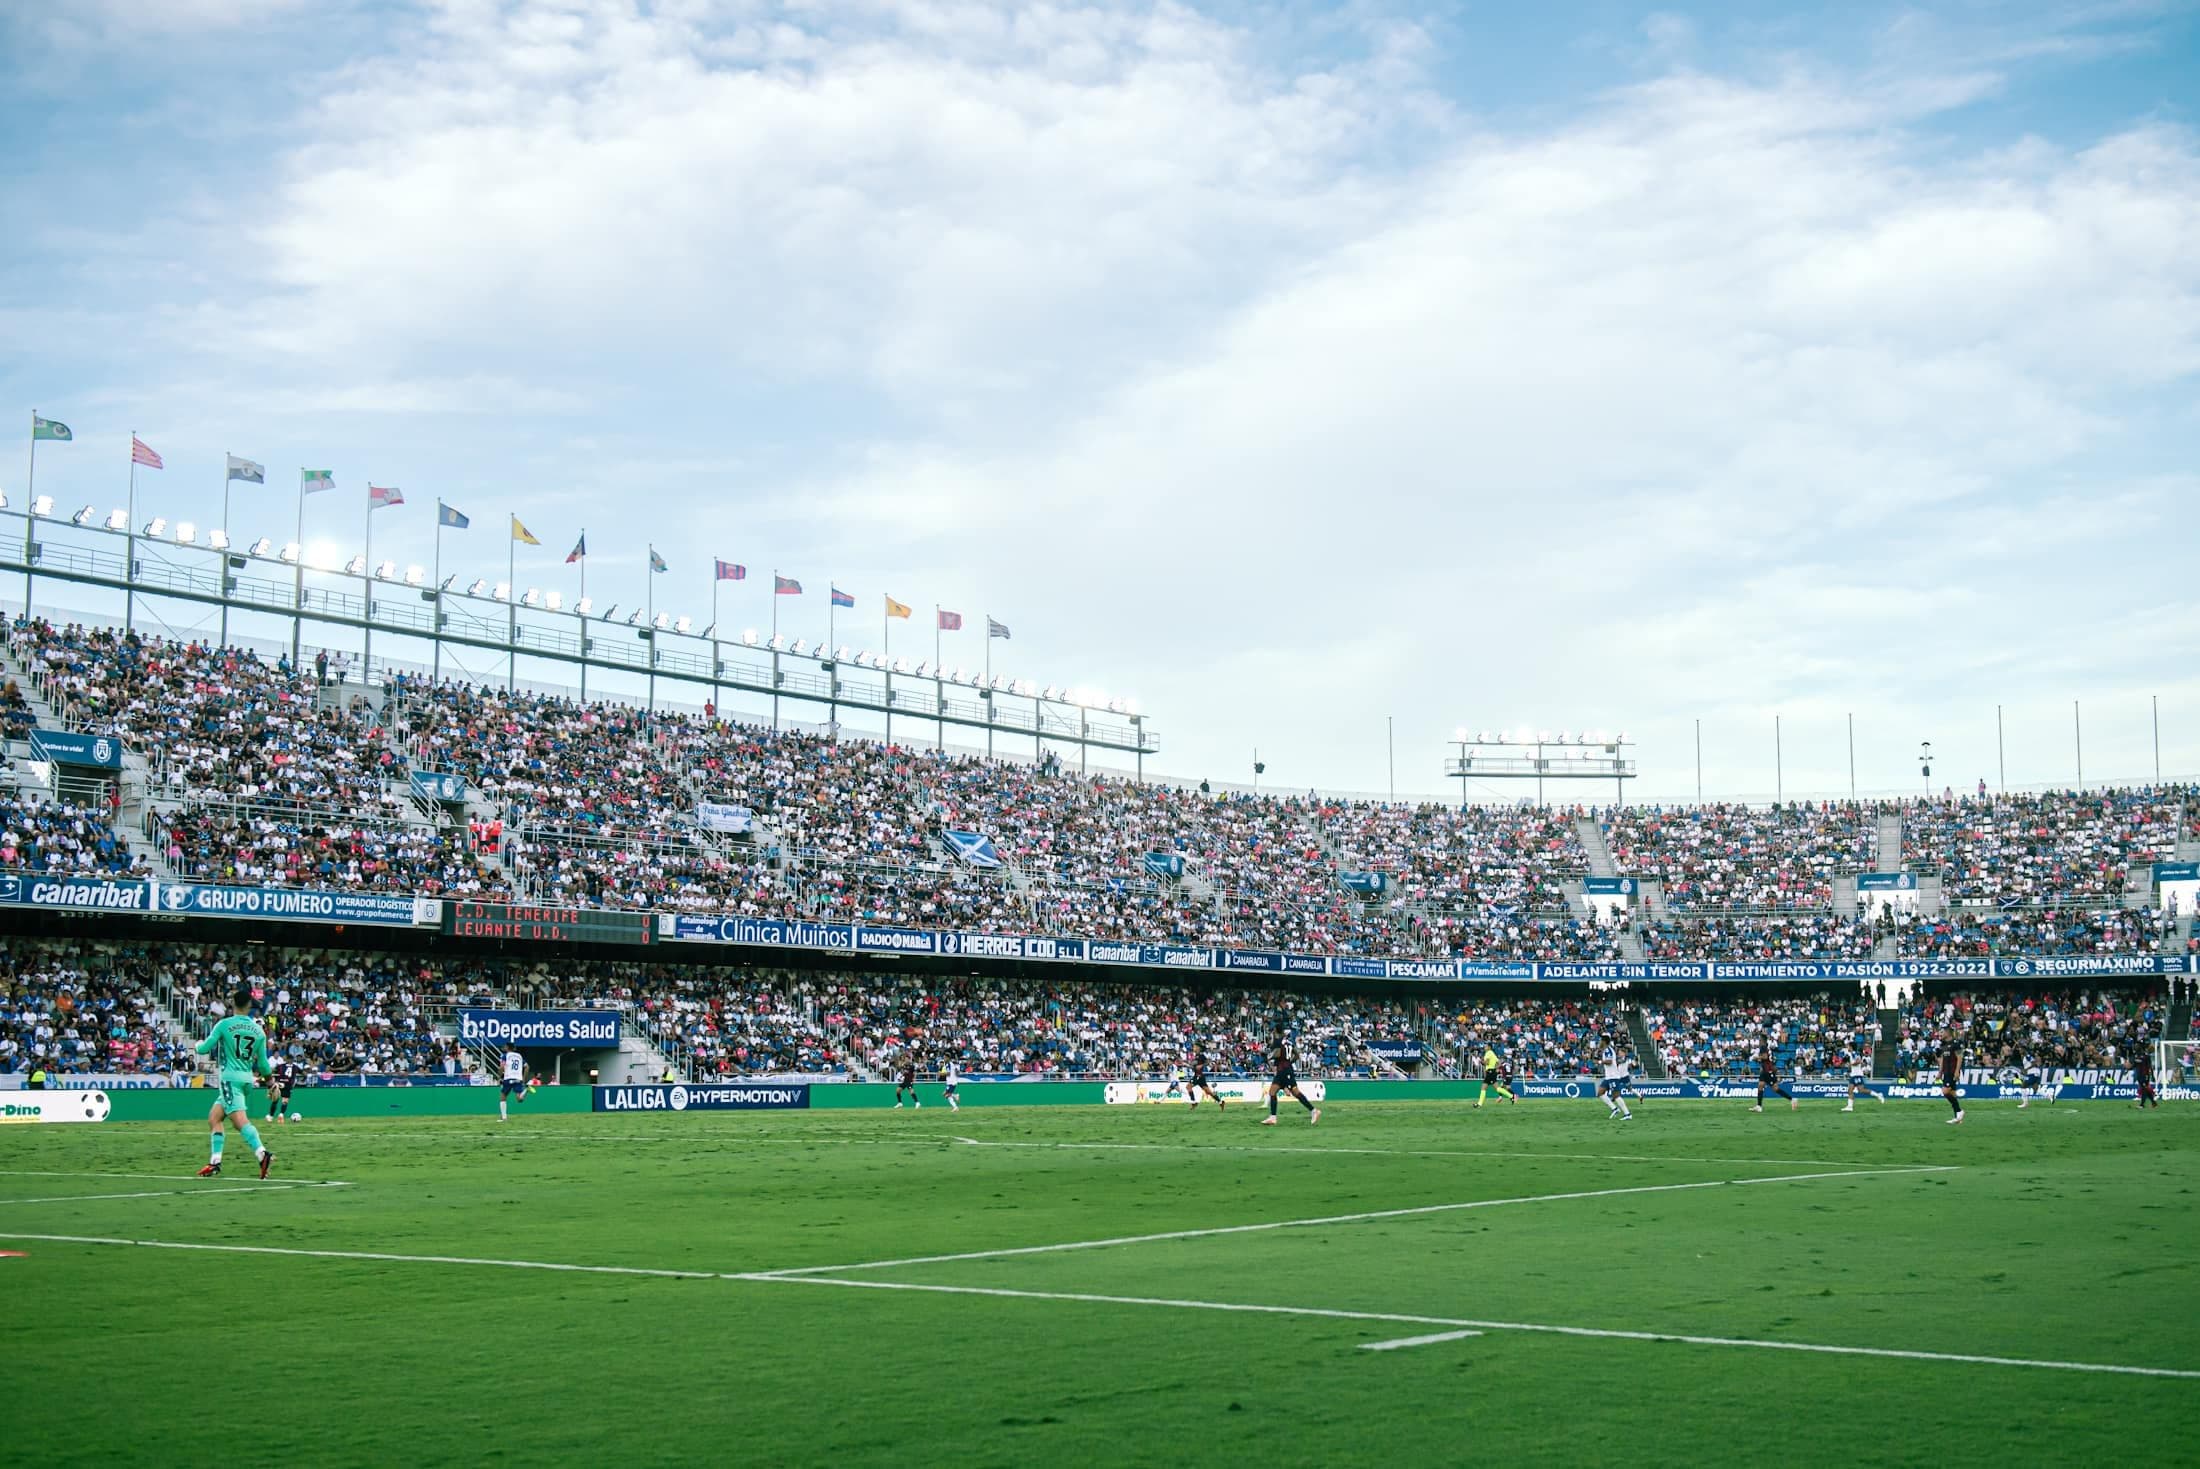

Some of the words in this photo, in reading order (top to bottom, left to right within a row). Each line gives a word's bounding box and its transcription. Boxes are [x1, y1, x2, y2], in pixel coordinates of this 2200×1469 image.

[31, 880, 144, 909] canaribat
[199, 889, 259, 911] GRUPO
[263, 893, 333, 915] FUMERO
[336, 897, 377, 908] OPERADOR
[455, 905, 493, 919] C.D.
[506, 907, 578, 923] TENERIFE
[455, 923, 521, 938] LEVANTE
[533, 925, 568, 940] U.D.
[720, 917, 780, 944] Clínica
[785, 923, 848, 947] Muiños
[861, 933, 892, 946] RADIO
[960, 936, 1021, 957] HIERROS
[1024, 940, 1056, 958] ICOD
[1092, 945, 1140, 962] canaribat
[1164, 950, 1211, 966] canaribat
[1391, 963, 1455, 977] PESCAMAR
[1544, 967, 1617, 977] ADELANTE
[1622, 967, 1646, 977] SIN
[1652, 967, 1701, 977] TEMOR
[1716, 965, 1817, 977] SENTIMIENTO
[1822, 965, 1832, 976] Y
[1837, 963, 1894, 976] PASIÓN
[1900, 963, 1987, 975] 1922-2022
[488, 1019, 564, 1042] Deportes
[569, 1020, 615, 1040] Salud
[234, 1034, 255, 1060] 13
[1525, 1085, 1563, 1096] hospiten
[1792, 1084, 1812, 1092] Islas
[1888, 1086, 1967, 1098] HiperDo
[605, 1088, 666, 1110] LALIGA
